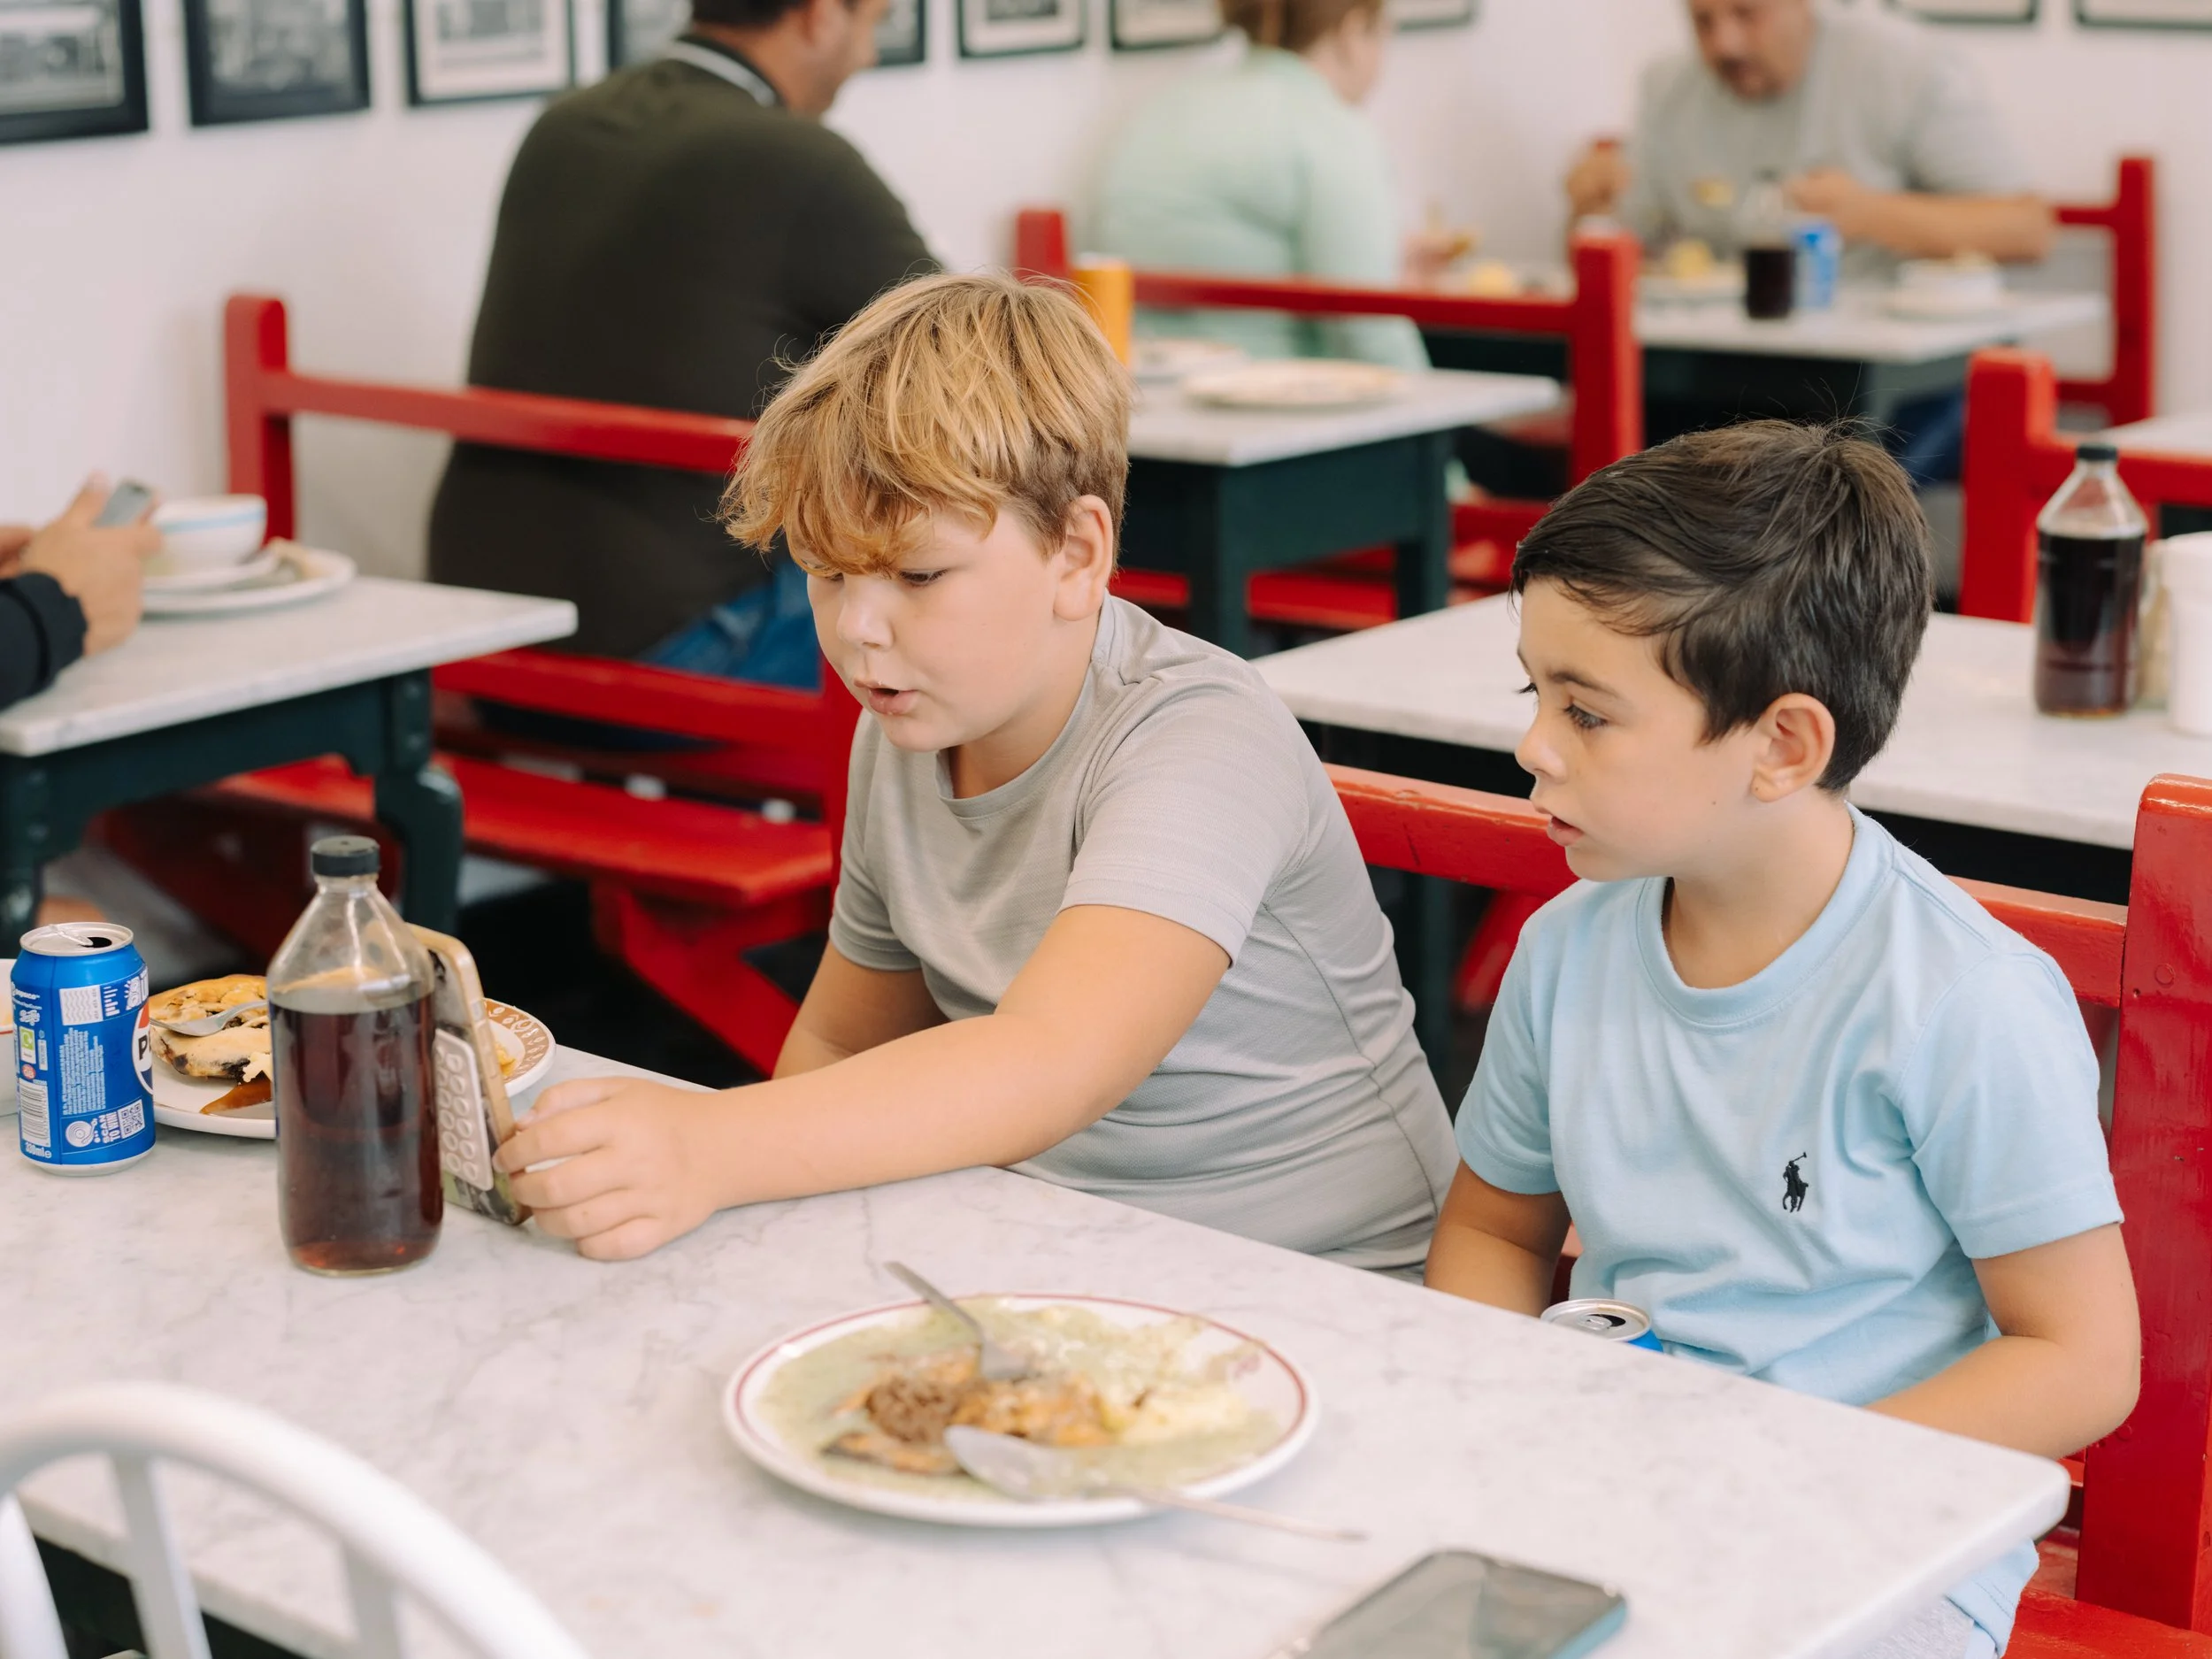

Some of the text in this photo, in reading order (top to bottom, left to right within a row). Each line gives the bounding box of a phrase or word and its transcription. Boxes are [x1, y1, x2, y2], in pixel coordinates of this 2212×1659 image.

[138, 1033, 151, 1061] P
[98, 1114, 110, 1144] SCAN
[108, 1129, 121, 1142] TO
